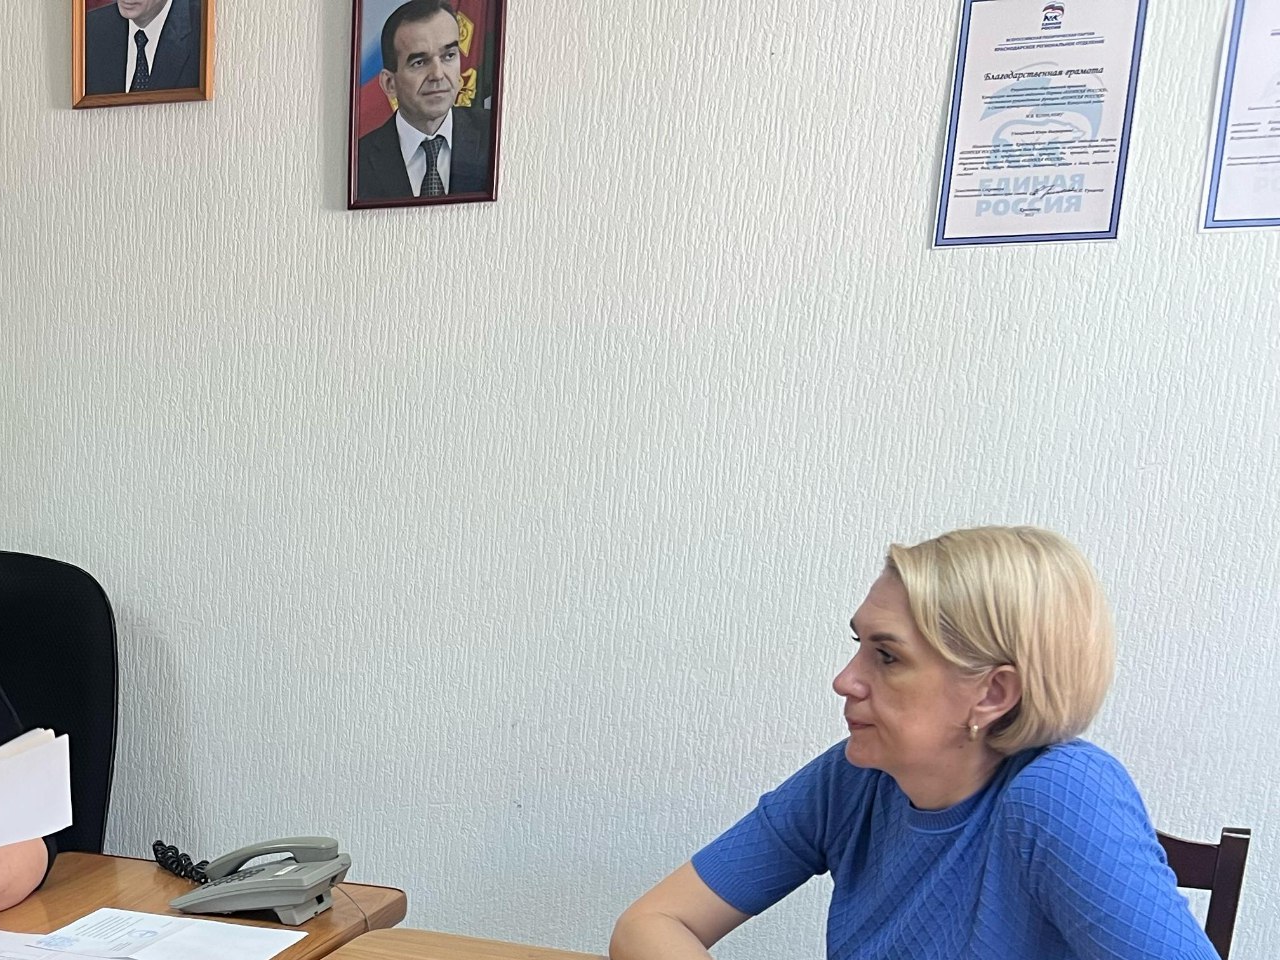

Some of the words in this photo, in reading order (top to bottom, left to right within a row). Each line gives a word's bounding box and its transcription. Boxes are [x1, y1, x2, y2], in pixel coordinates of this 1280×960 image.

[984, 70, 1063, 81] Благодарственная
[1065, 67, 1104, 78] грамота
[978, 173, 1085, 193] ЕДИНАЯ
[975, 195, 1082, 217] РОССИЯ
